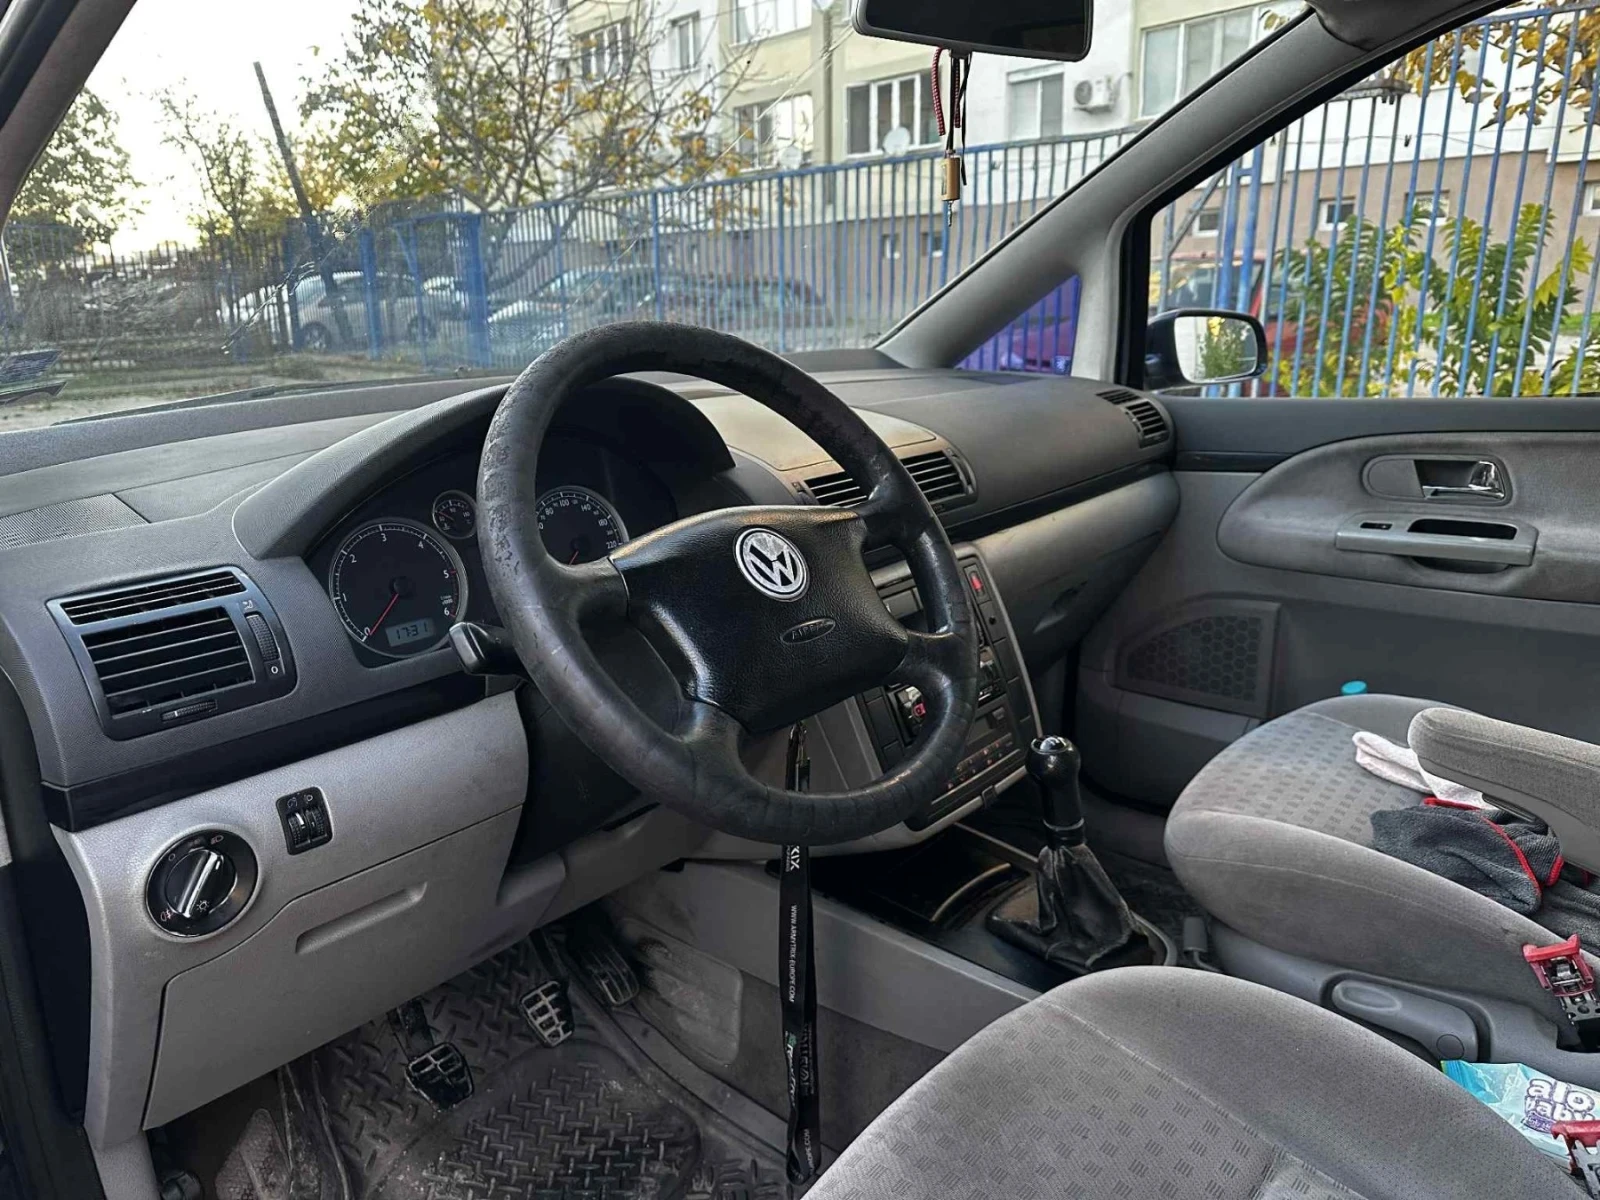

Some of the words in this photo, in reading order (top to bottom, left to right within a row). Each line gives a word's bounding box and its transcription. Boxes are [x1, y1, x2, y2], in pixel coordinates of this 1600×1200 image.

[559, 499, 571, 508] 100
[581, 503, 593, 513] 140
[544, 506, 555, 516] 80
[381, 533, 387, 542] 3
[418, 540, 425, 549] 4
[349, 553, 357, 563] 2
[443, 570, 450, 579] 5
[444, 607, 450, 616] 6
[1527, 1078, 1595, 1112] alo
